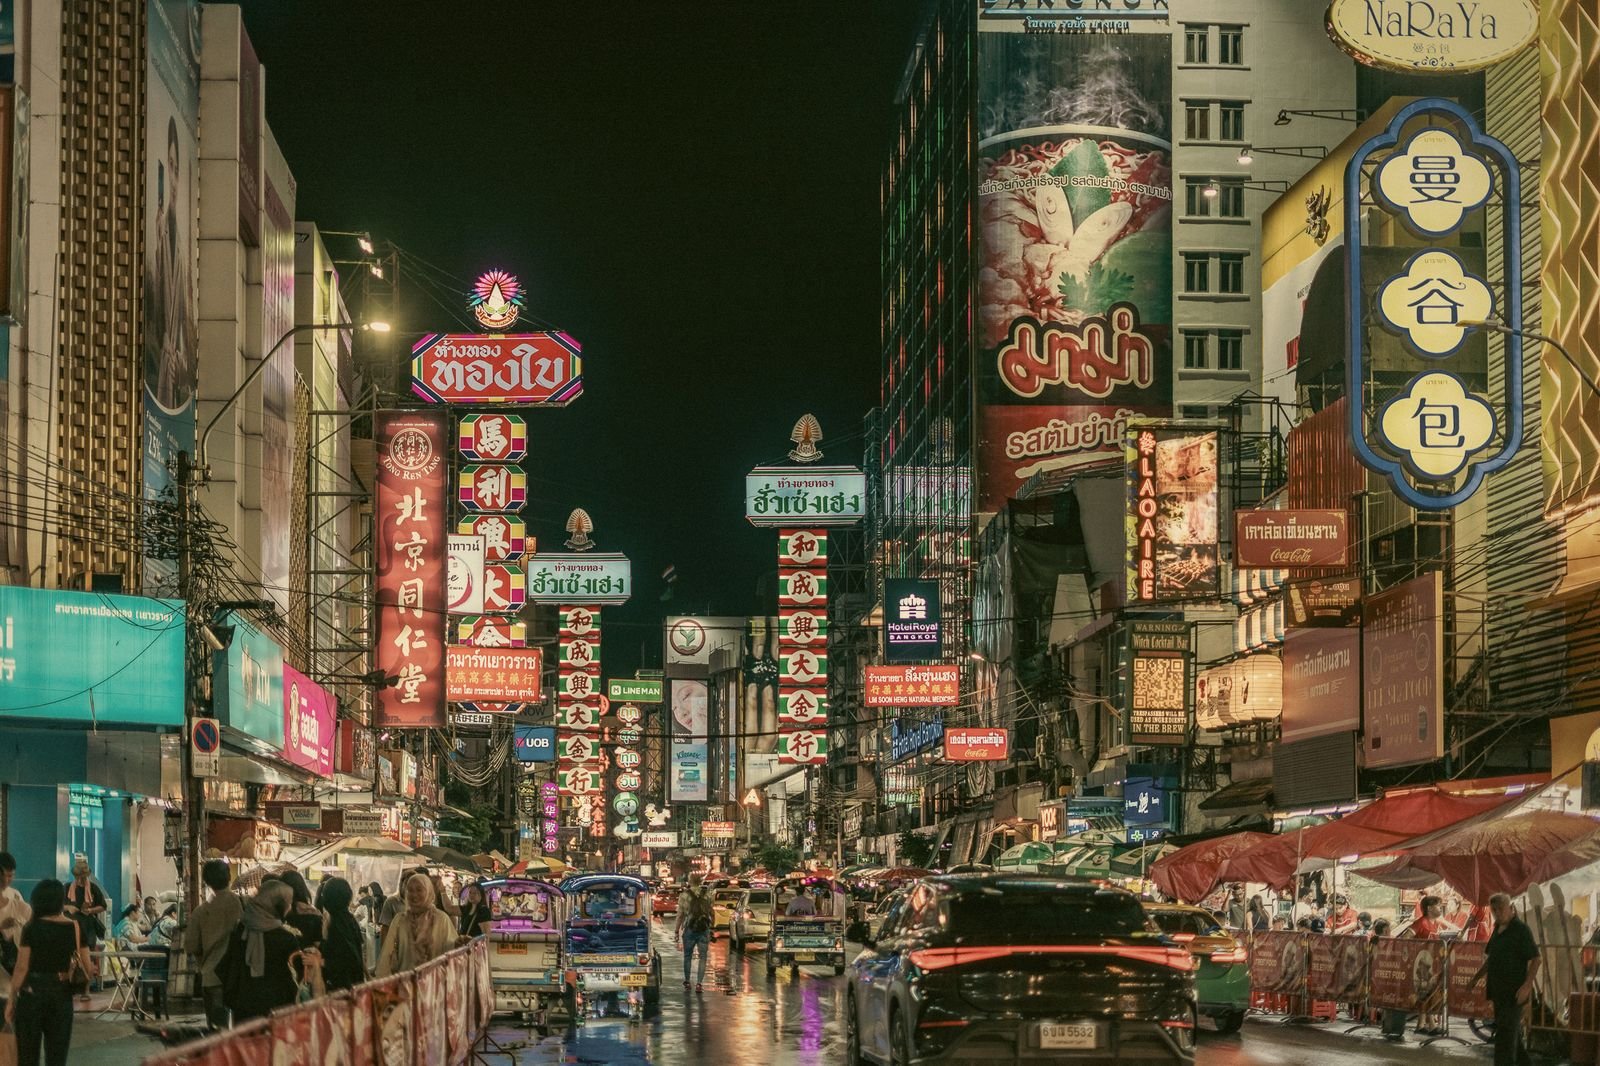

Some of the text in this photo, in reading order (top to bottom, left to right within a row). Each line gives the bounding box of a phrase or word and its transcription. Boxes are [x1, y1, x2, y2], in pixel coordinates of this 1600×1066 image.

[1363, 0, 1499, 39] NaRaYa
[434, 340, 501, 358] ห้างทอง
[997, 307, 1154, 398] มาม่า
[431, 343, 564, 392] ทองใบ
[383, 455, 441, 480] TONG REN TANG
[777, 477, 835, 488] ห้างขายทอง
[753, 484, 860, 515] ฮั่วเซ่งเฮง
[554, 562, 604, 572] ห้างขายทอง
[532, 567, 625, 594] ฮั่วเซ่งเฮง
[394, 487, 428, 704] 北京同仁堂
[888, 622, 938, 633] Hotel Royal
[1135, 624, 1178, 632] WARNING
[909, 695, 931, 703] NATURAL
[1133, 724, 1184, 733] IN THE BREW
[526, 739, 549, 748] UOB
[1067, 1026, 1093, 1037] 5532
